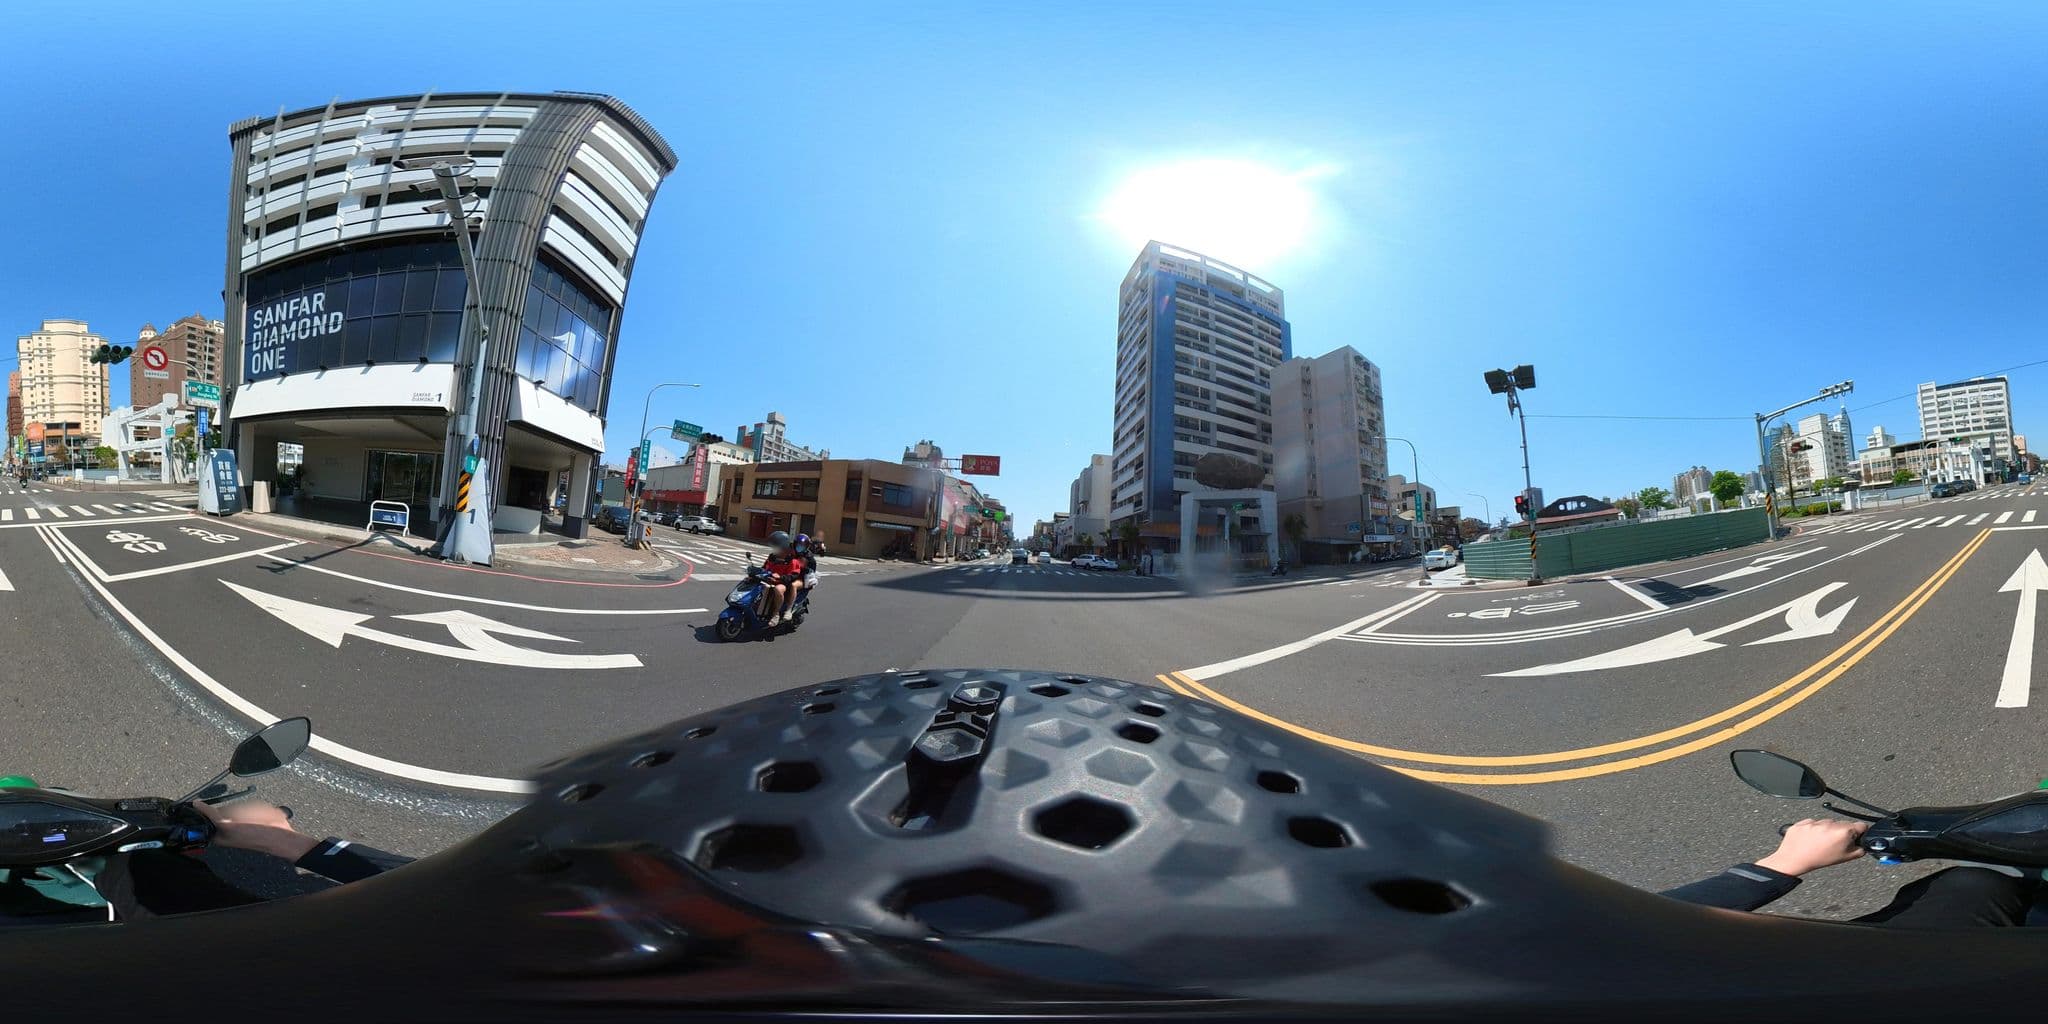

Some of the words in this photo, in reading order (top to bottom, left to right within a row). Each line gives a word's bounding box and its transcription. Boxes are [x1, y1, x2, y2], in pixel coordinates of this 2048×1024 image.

[253, 292, 325, 329] SANFAR
[252, 311, 344, 351] DIAMOND
[251, 347, 286, 374] ONE
[436, 393, 442, 402] 1
[467, 508, 476, 525] 1
